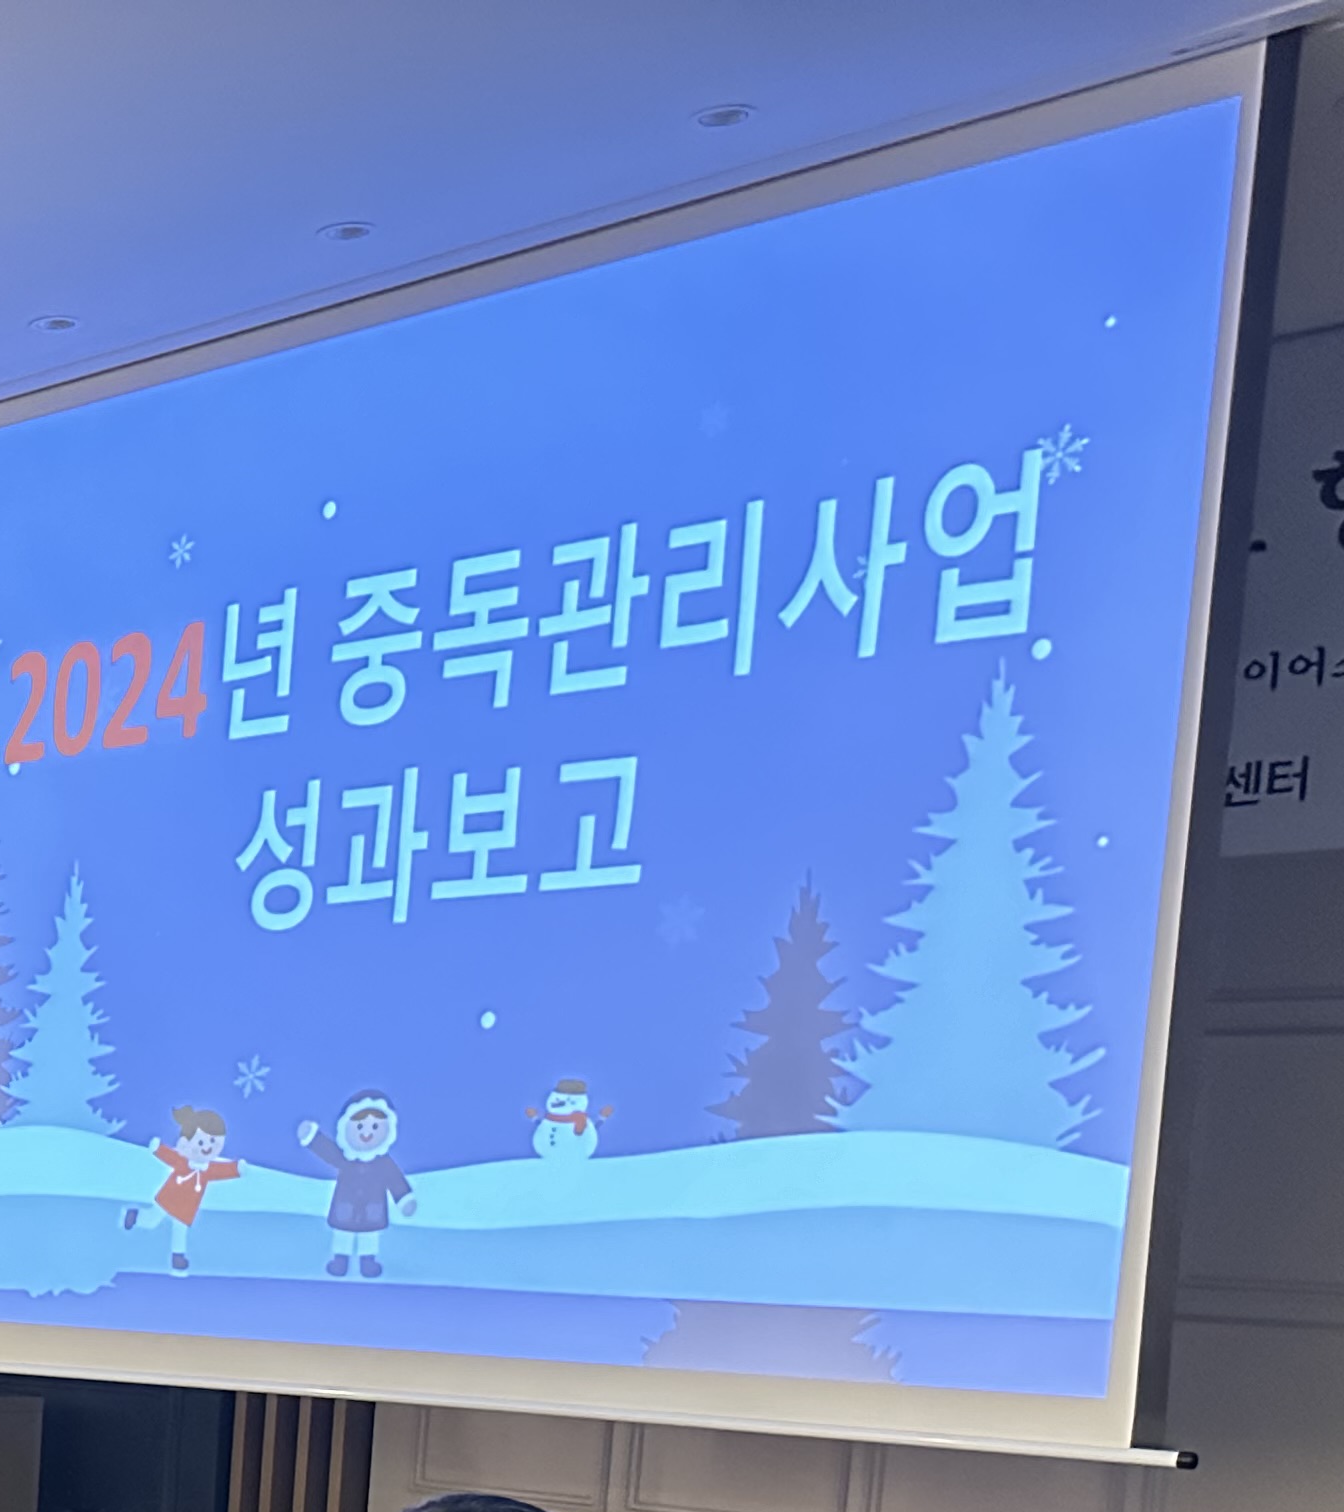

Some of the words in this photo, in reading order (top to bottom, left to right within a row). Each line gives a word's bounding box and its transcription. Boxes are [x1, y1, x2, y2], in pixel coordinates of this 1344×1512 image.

[4, 586, 298, 766] 2024년
[330, 448, 1044, 728] 중독관리사업
[234, 756, 642, 932] 성과보고
[1224, 755, 1310, 808] 센터
